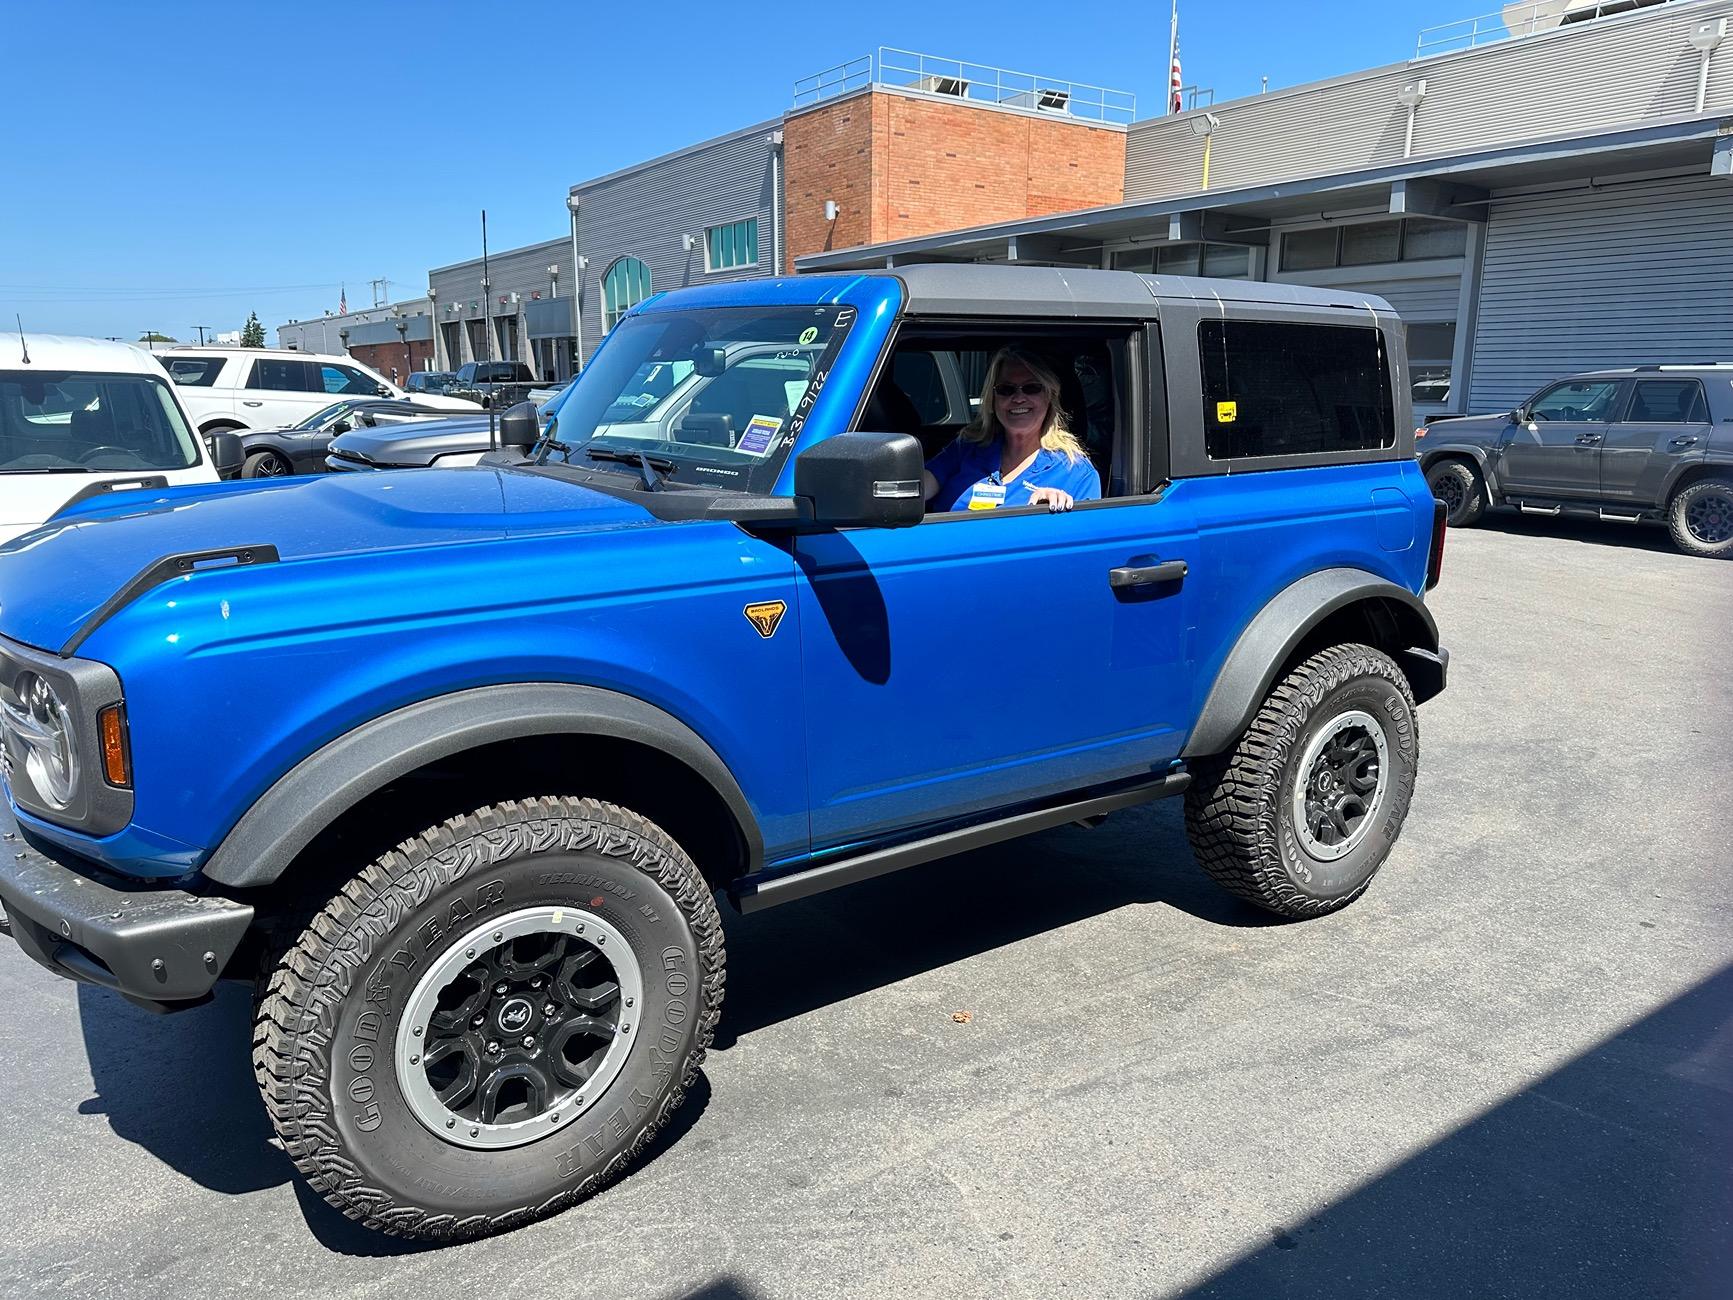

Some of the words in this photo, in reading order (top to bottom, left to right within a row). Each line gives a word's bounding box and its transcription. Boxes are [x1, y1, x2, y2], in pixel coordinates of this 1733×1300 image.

[802, 330, 815, 342] 14
[695, 466, 739, 476] BRONCO
[539, 872, 637, 900] TERRITORY
